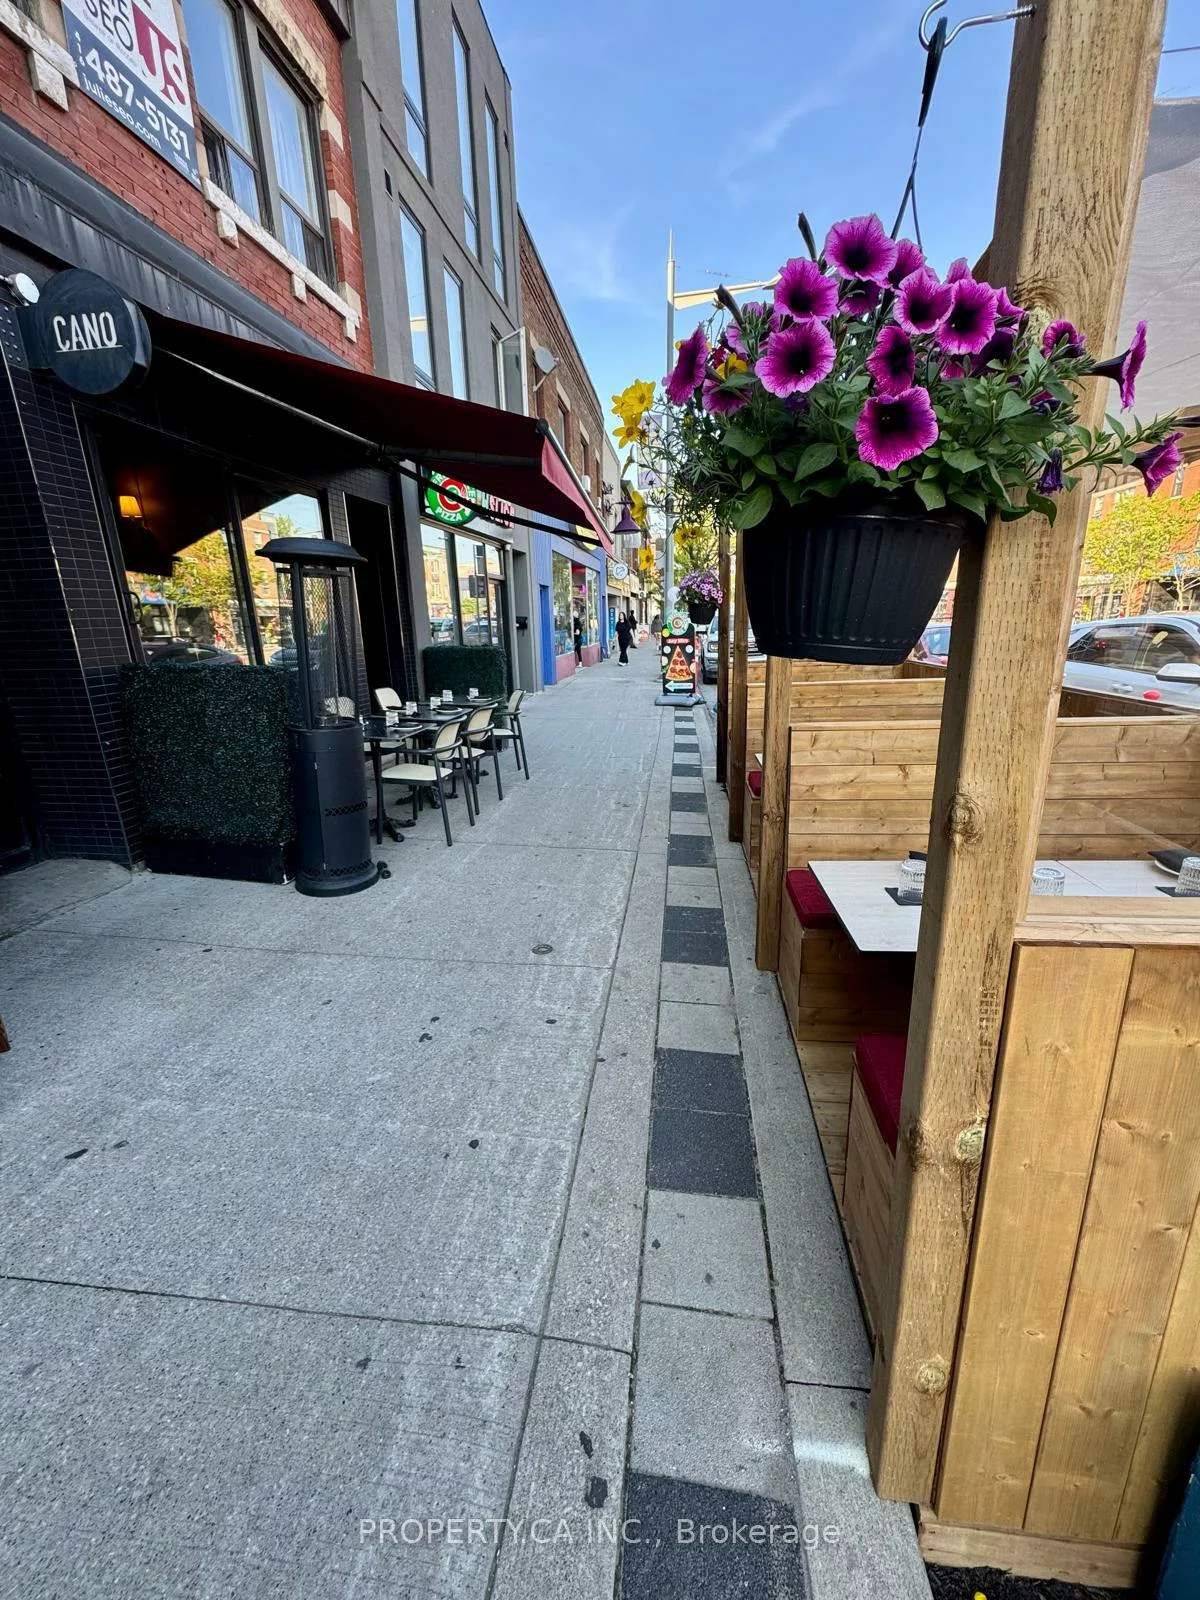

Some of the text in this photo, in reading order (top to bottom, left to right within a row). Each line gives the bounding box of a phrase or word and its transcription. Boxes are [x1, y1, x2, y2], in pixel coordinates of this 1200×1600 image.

[83, 73, 161, 149] julieseo.com
[86, 48, 190, 161] 487-5131
[53, 311, 118, 350] CANO
[434, 507, 462, 521] PIZZA
